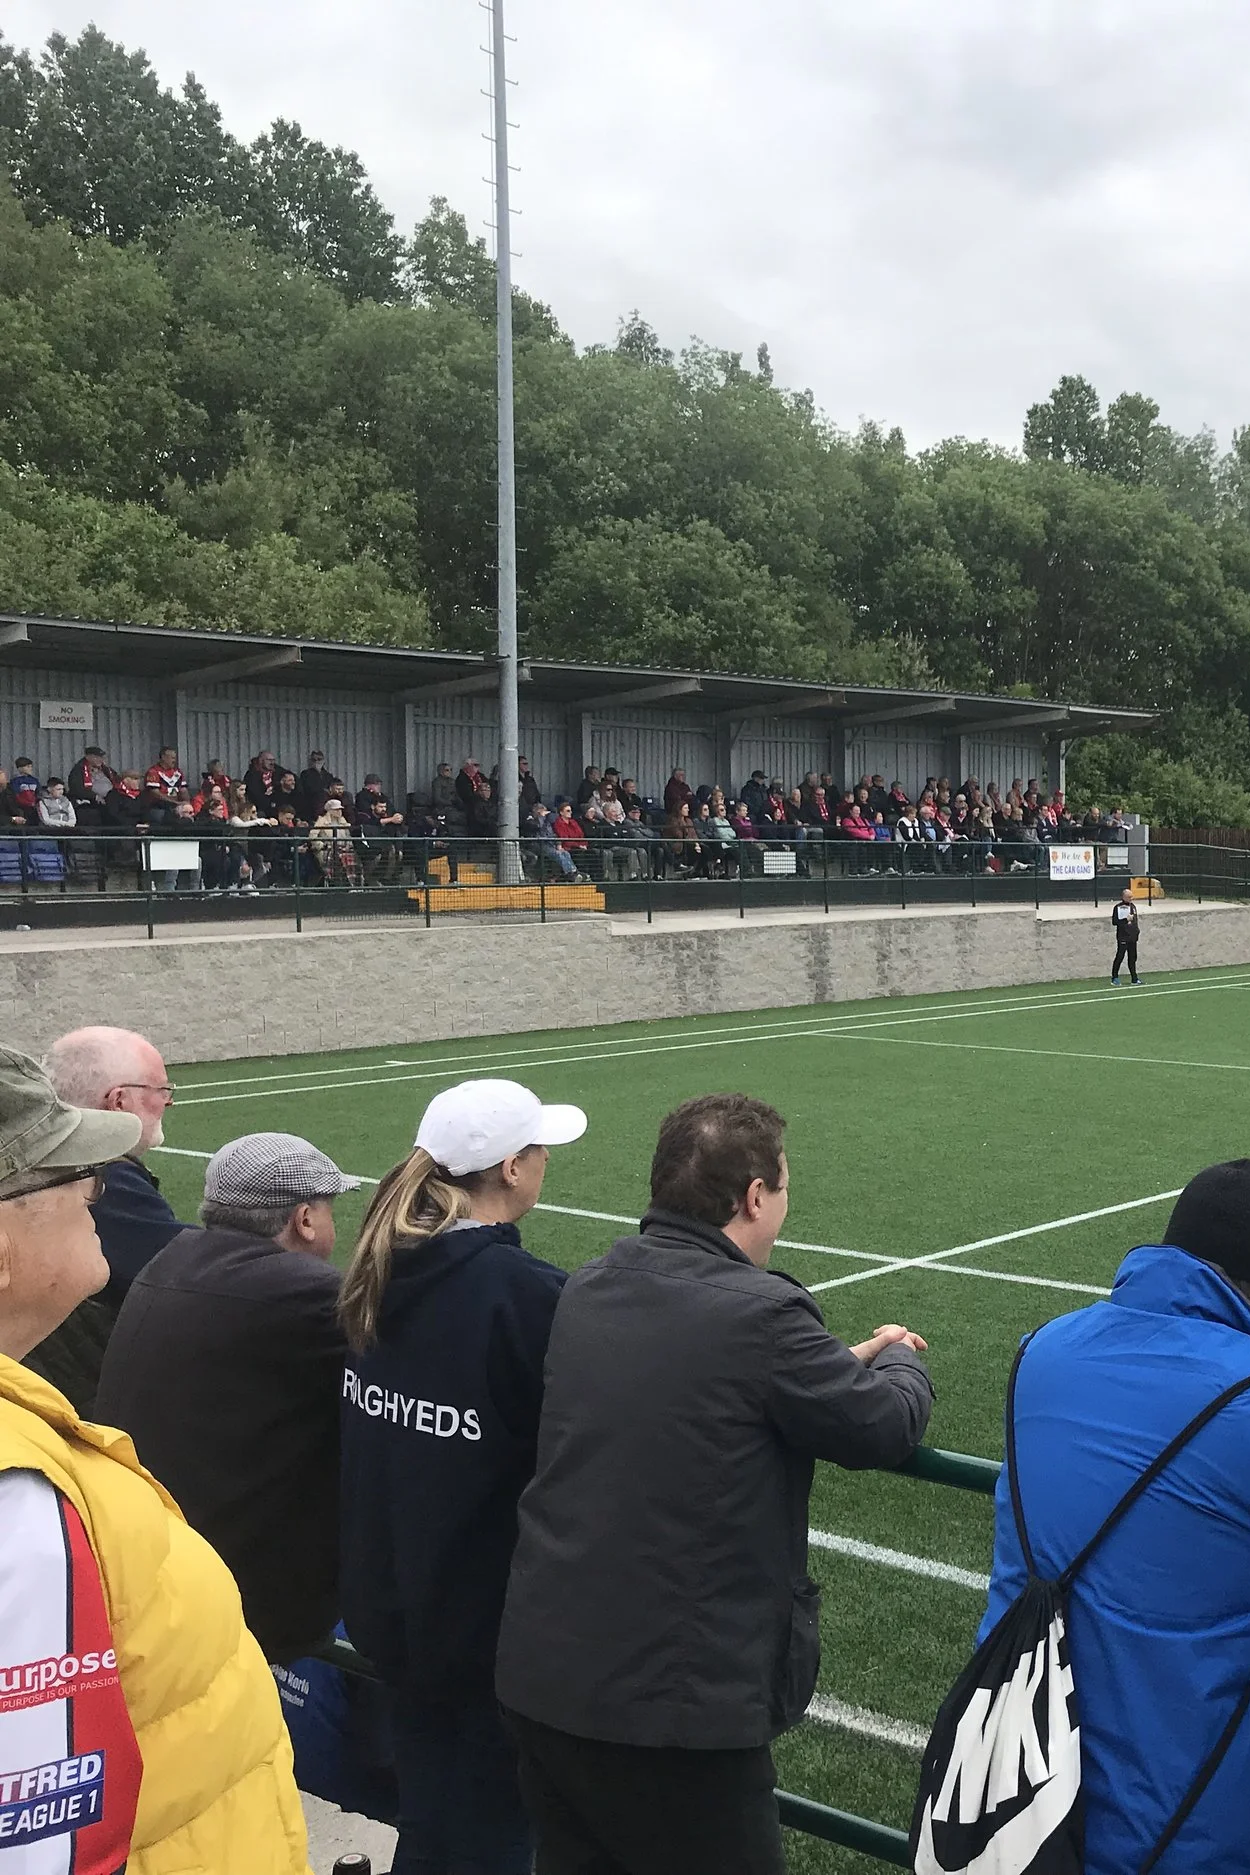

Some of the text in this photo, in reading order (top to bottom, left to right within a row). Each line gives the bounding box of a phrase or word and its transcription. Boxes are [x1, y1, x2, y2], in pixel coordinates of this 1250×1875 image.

[48, 715, 86, 724] SMOKING
[342, 1367, 482, 1441] RUGHYEDS
[2, 1676, 119, 1709] PURPOSE IS OUR PASSION
[89, 1789, 97, 1813] 1
